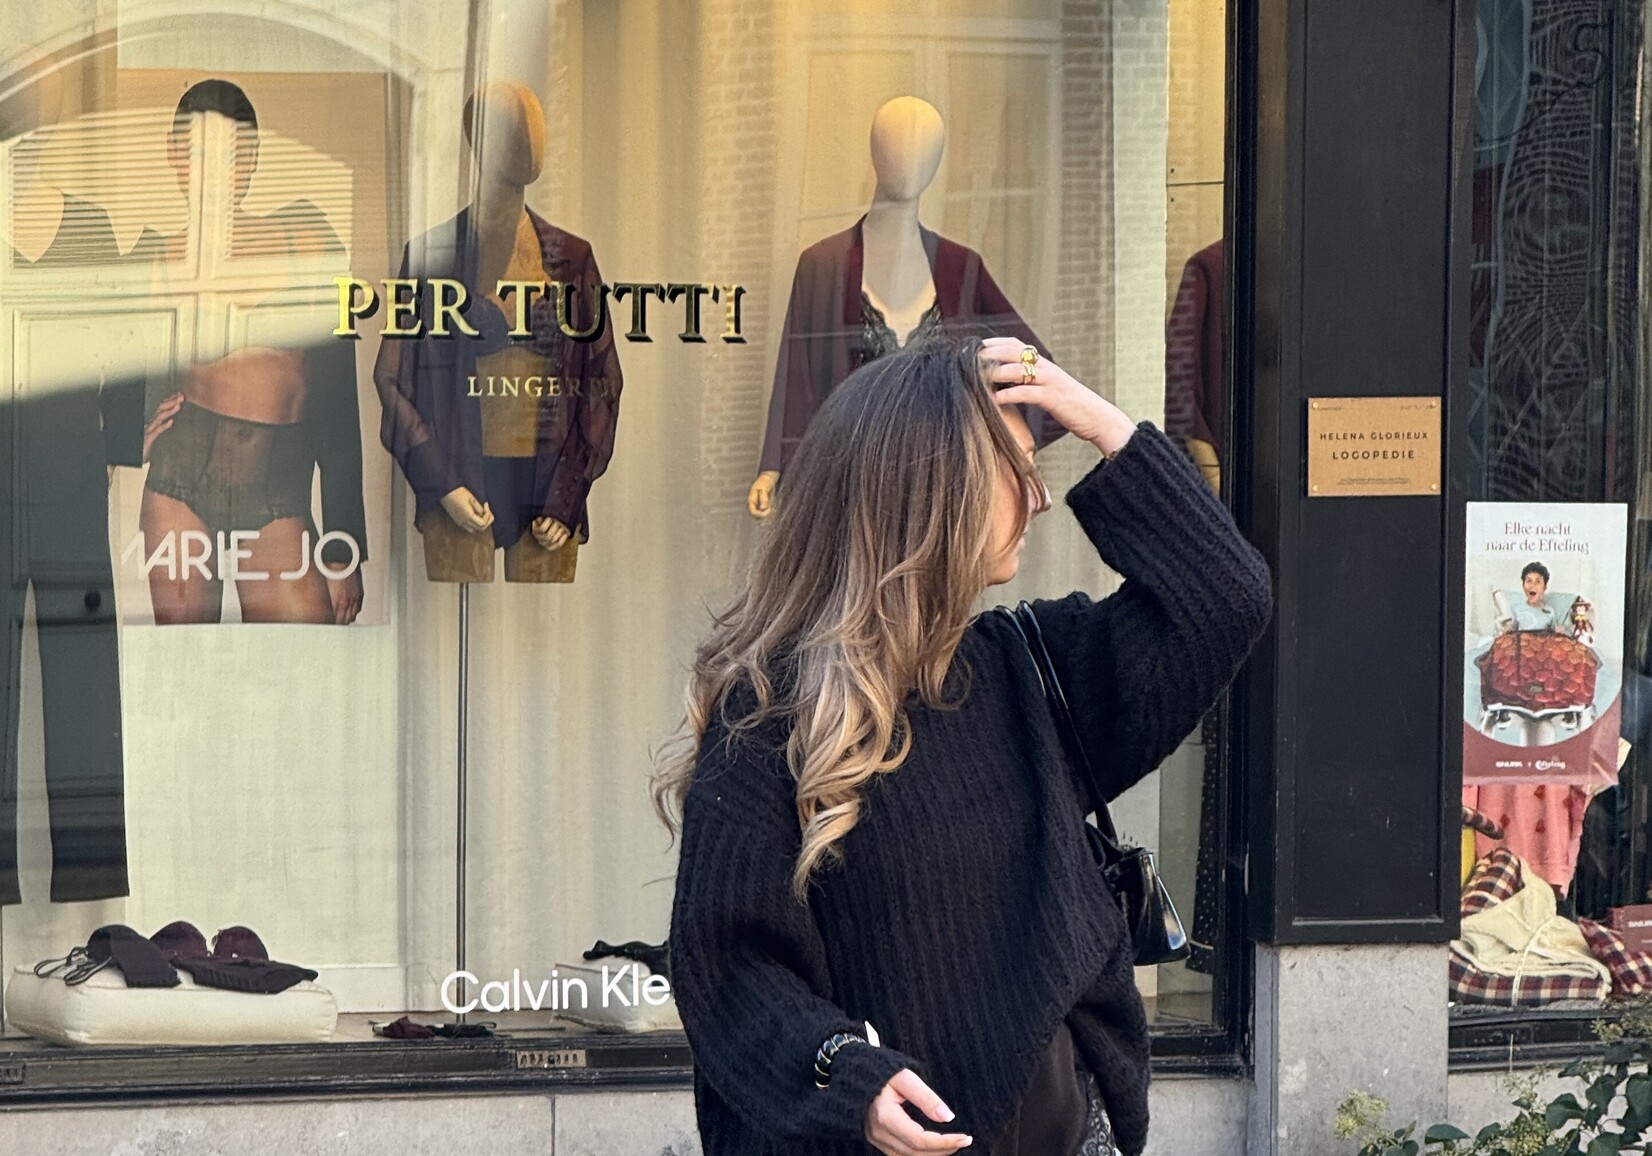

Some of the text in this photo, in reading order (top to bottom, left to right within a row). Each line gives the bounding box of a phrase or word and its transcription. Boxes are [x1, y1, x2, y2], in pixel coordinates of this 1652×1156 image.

[332, 276, 748, 344] PER TUTTI
[467, 375, 617, 398] LINGER
[1319, 431, 1428, 441] HELENA GLORIEUX
[1332, 450, 1415, 460] LOGOPEDIE
[1504, 522, 1571, 535] Elke nacht
[280, 530, 360, 581] JO
[1486, 539, 1589, 554] naar de Efteling
[440, 963, 671, 1014] Calvin Kle
